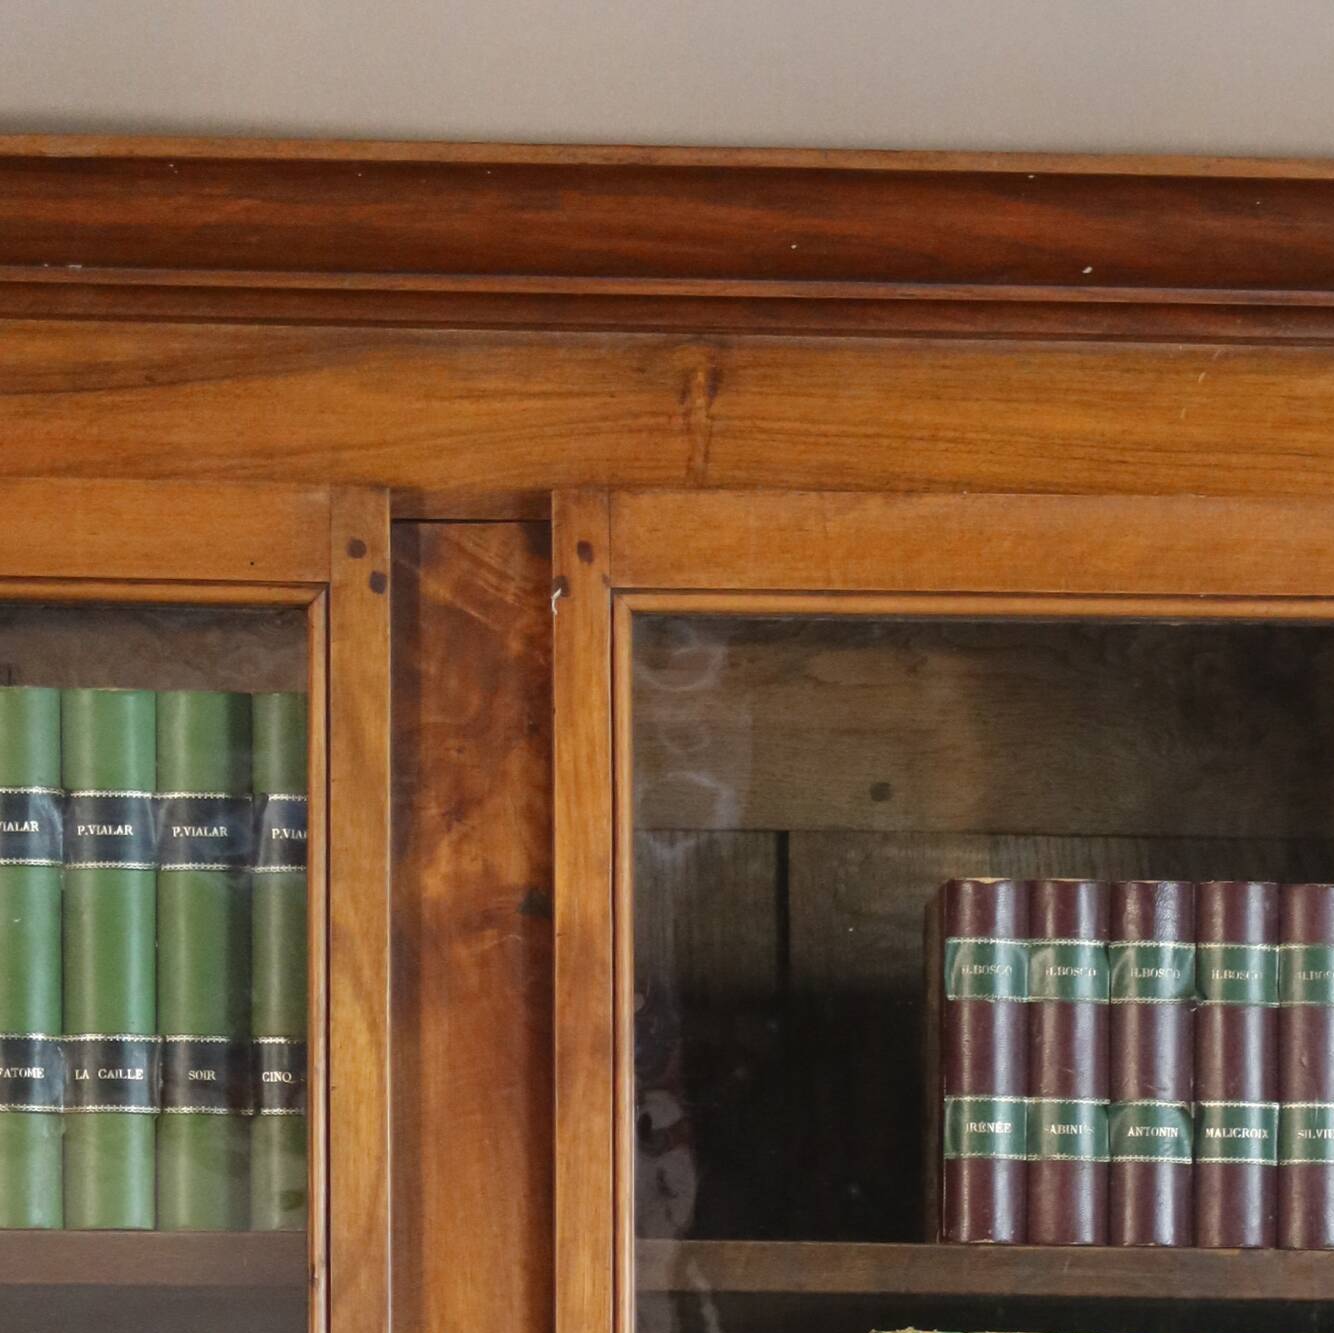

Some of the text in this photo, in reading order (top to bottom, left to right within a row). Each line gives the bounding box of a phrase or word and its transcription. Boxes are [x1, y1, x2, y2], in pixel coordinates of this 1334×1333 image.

[272, 827, 306, 840] P.VIA
[75, 1068, 143, 1080] LA CAILLE
[188, 1069, 216, 1081] SOIR
[262, 1070, 296, 1083] CINQ
[1127, 1126, 1178, 1138] ANTONIN
[1205, 1127, 1269, 1139] MALICROIX
